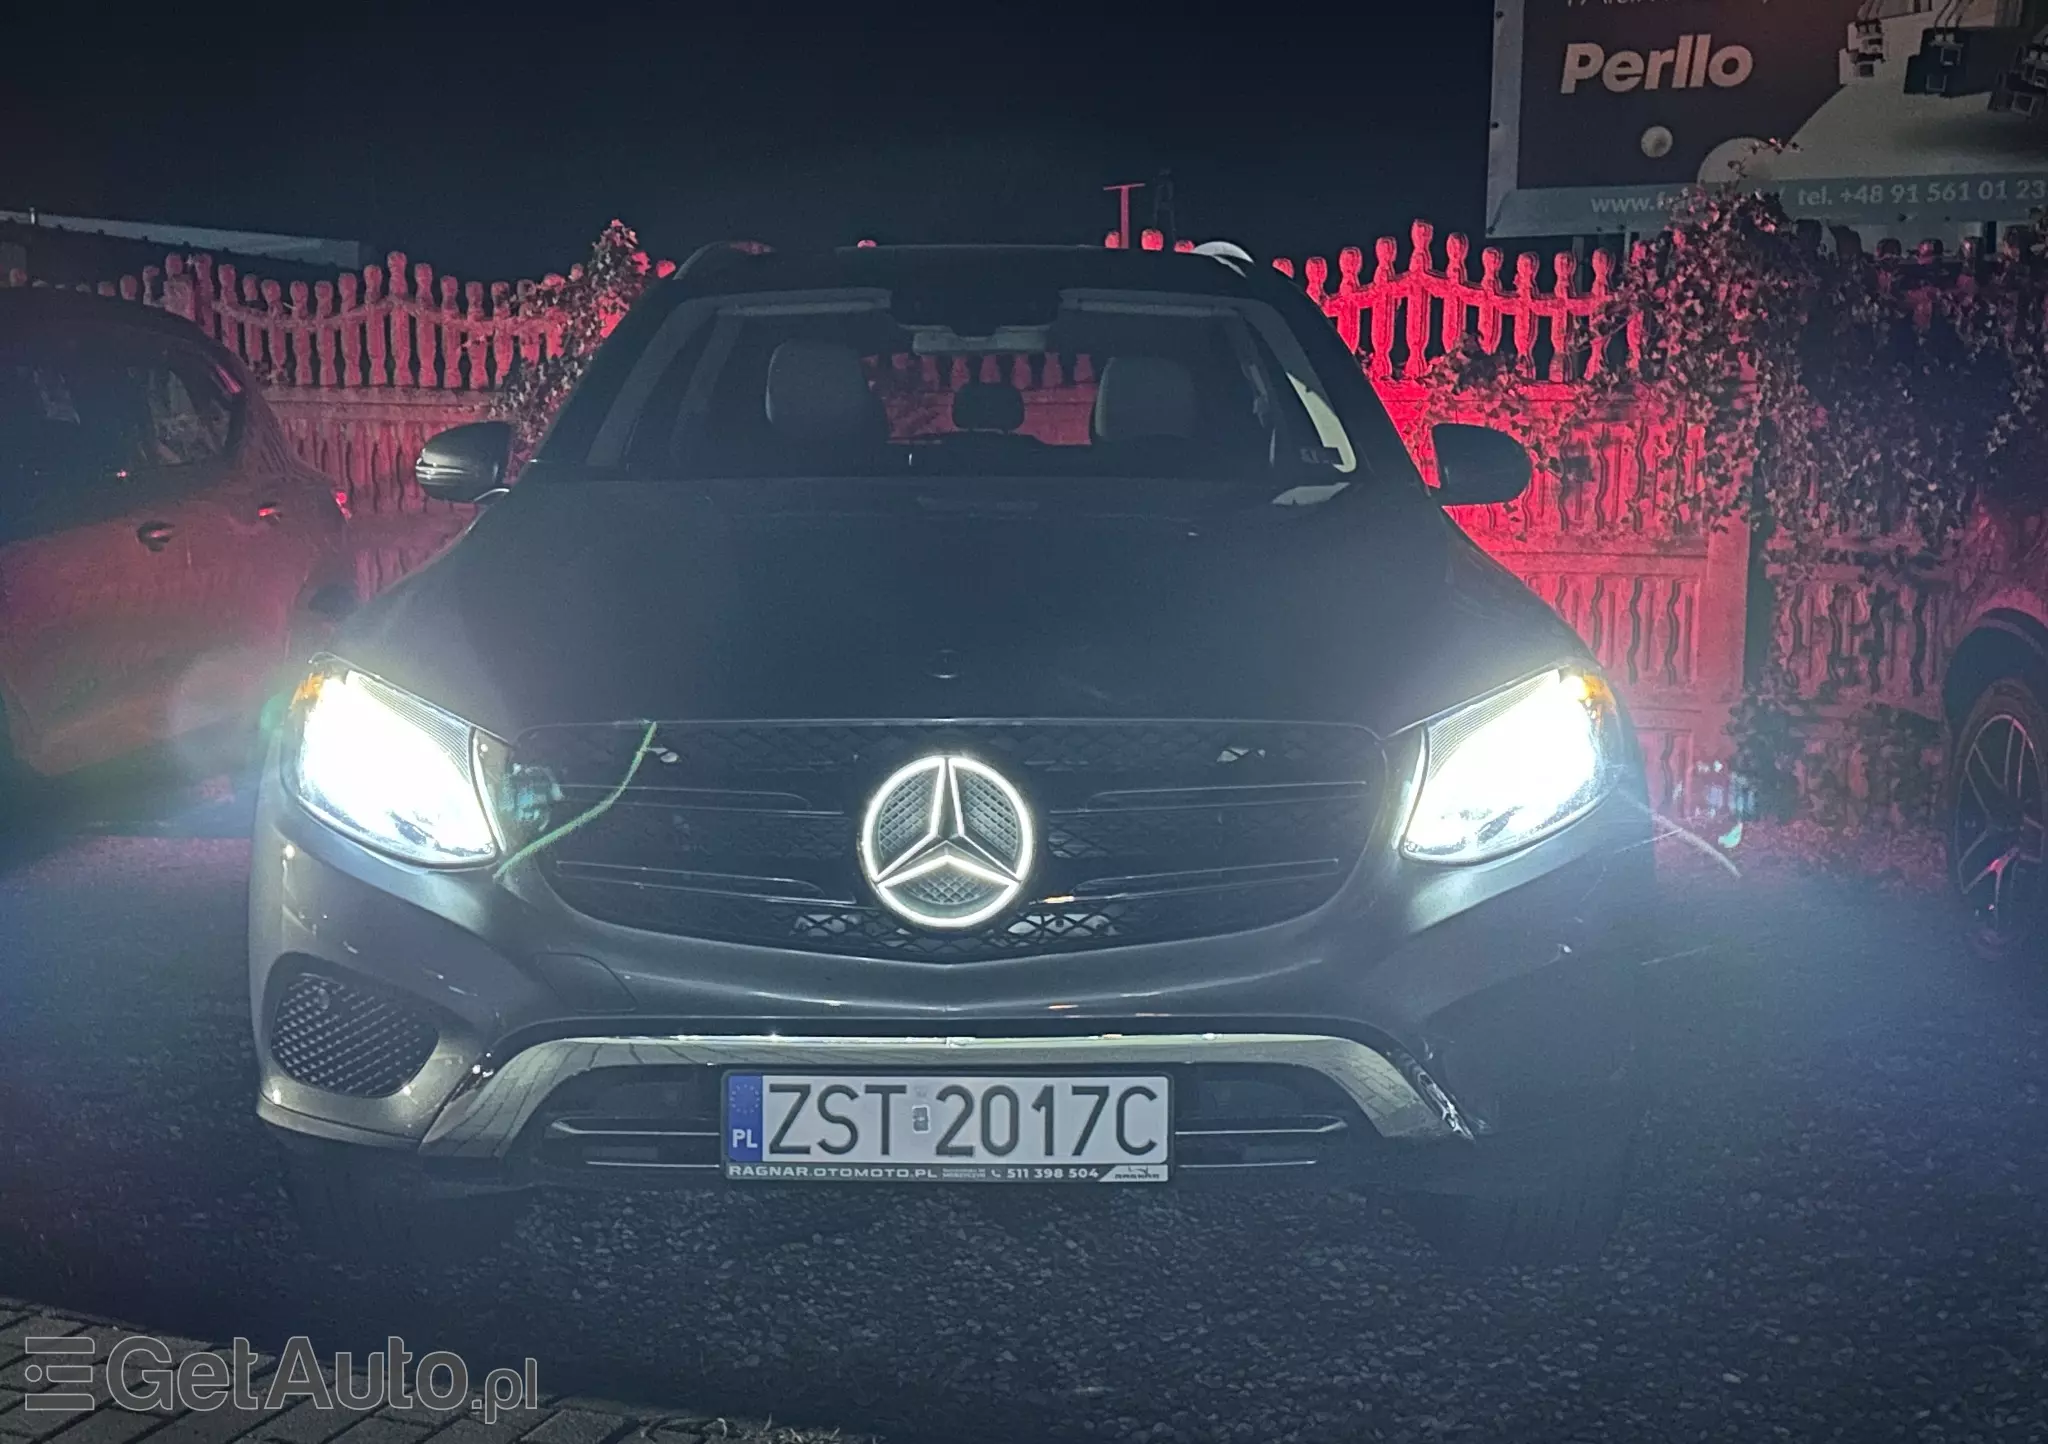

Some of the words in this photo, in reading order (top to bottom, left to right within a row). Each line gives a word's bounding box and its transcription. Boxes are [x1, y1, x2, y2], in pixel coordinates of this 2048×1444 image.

[1561, 34, 1753, 94] Perllo
[1797, 187, 1833, 205] tel.
[1840, 185, 1884, 204] +48
[1890, 184, 1919, 203] 91
[1927, 182, 1970, 202] 561
[1978, 180, 2007, 200] 01
[2015, 179, 2046, 199] 23
[768, 1084, 908, 1156] ZST
[935, 1084, 1158, 1157] 2017C
[732, 1129, 758, 1148] PL
[728, 1165, 938, 1179] RAGNAR.OTOMOTO.PL
[1006, 1168, 1029, 1179] 511
[1034, 1168, 1063, 1179] 398
[1068, 1168, 1099, 1178] 504
